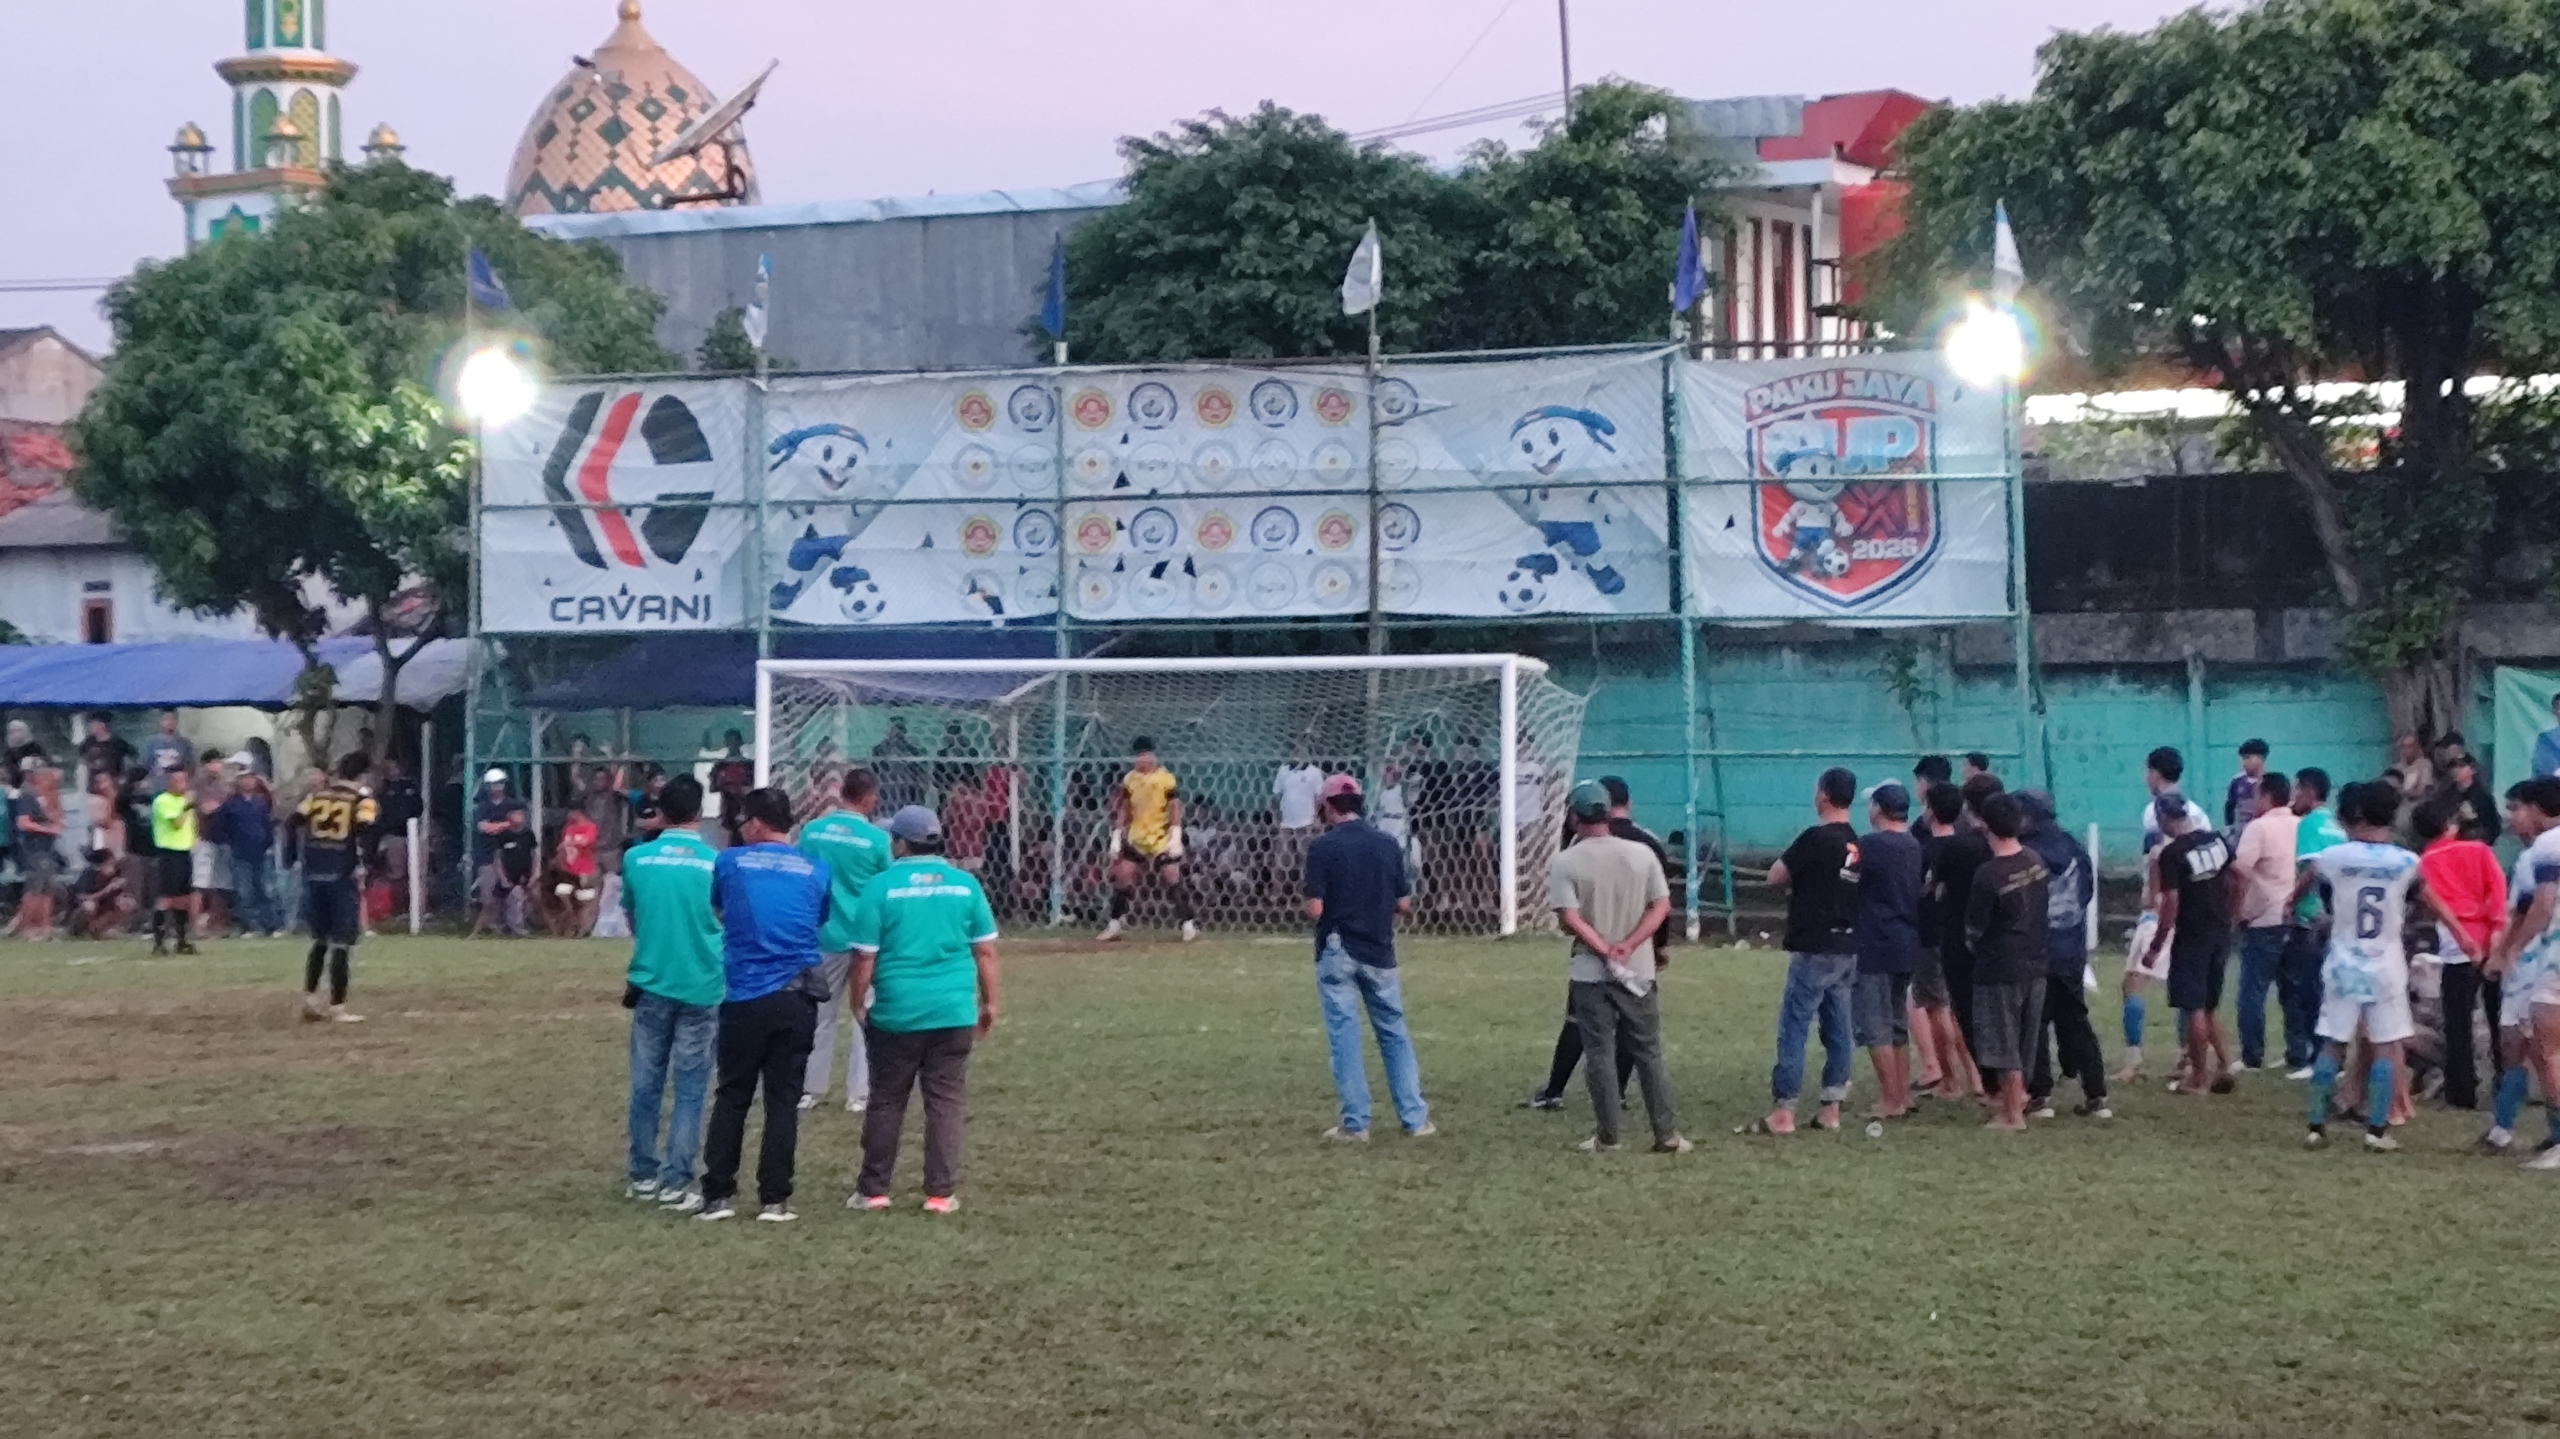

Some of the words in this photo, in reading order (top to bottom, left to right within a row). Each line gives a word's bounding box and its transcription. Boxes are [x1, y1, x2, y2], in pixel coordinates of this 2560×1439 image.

[1748, 372, 1837, 413] PAKU
[550, 595, 711, 624] CAVANI
[310, 800, 351, 840] 23
[2357, 886, 2386, 939] 6
